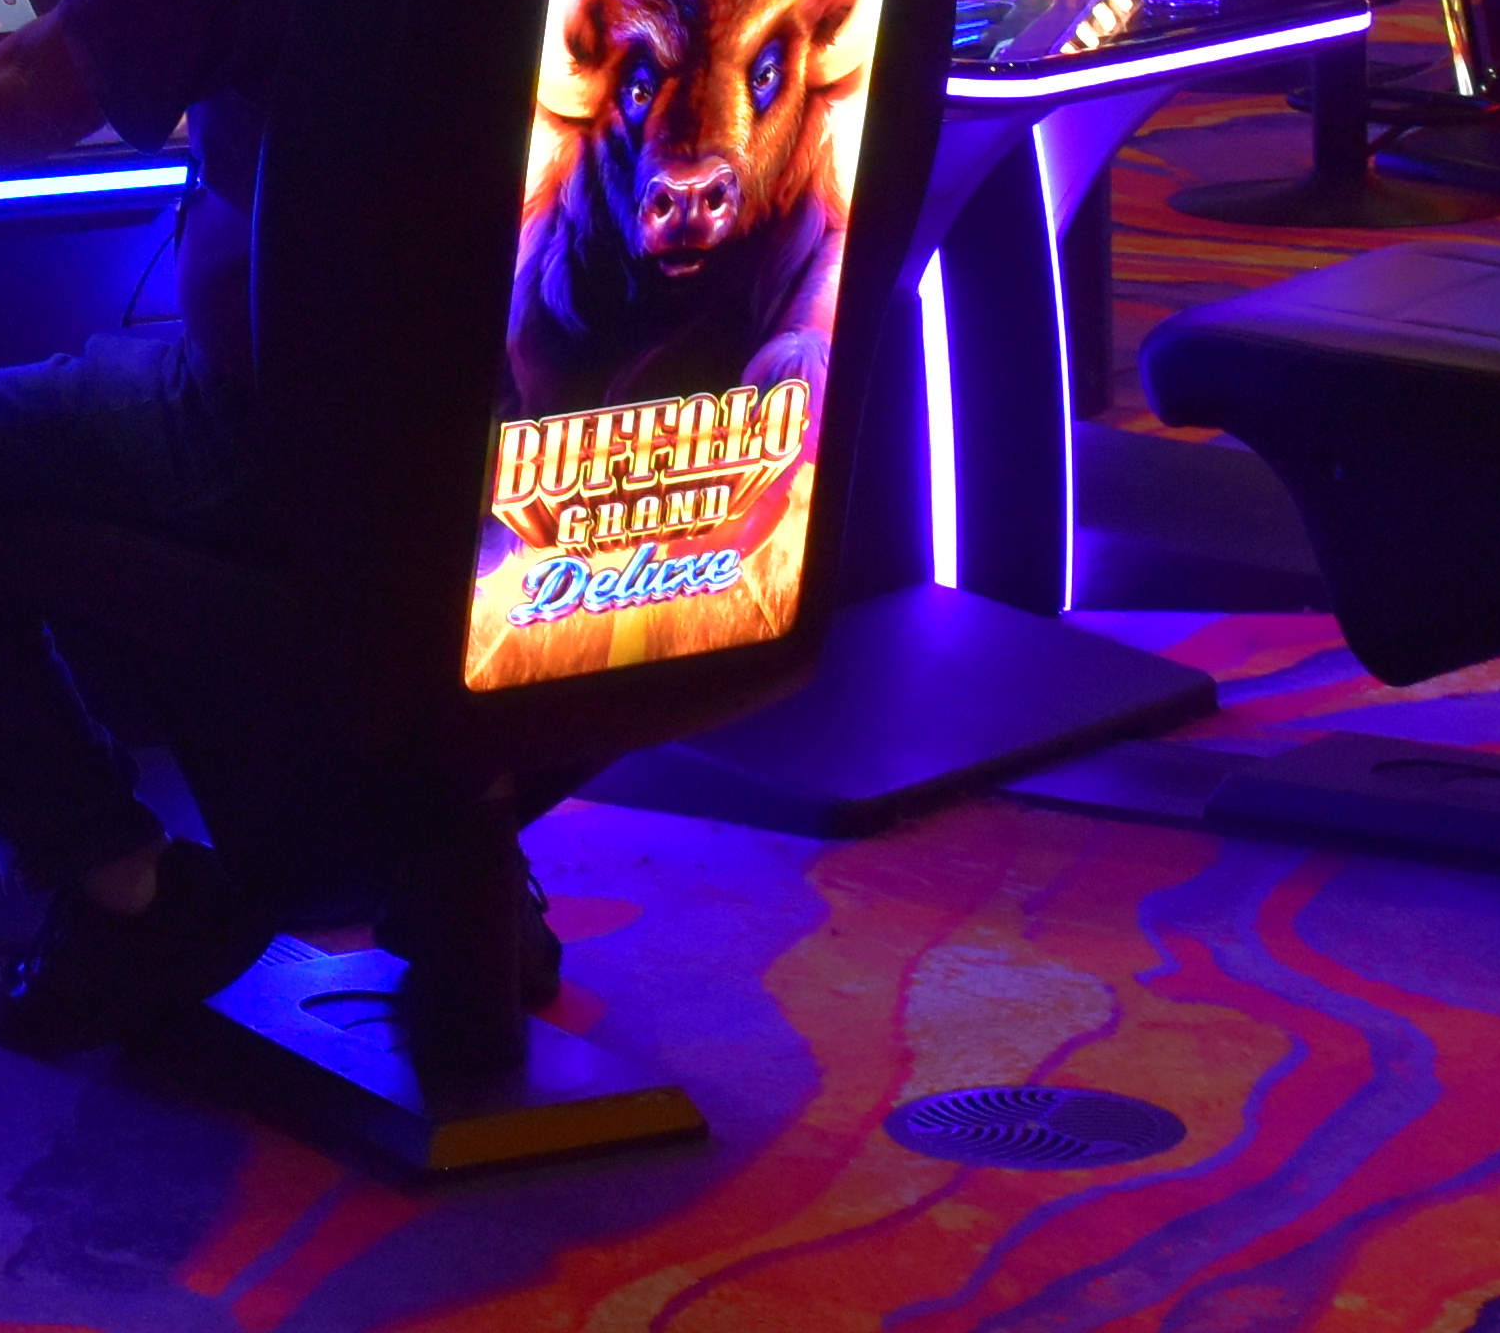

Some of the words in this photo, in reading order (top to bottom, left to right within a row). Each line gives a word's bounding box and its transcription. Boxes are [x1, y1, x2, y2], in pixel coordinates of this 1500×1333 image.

[492, 379, 809, 511] BUFFALO
[556, 483, 731, 546] GRAND
[507, 543, 742, 627] Deluxe
